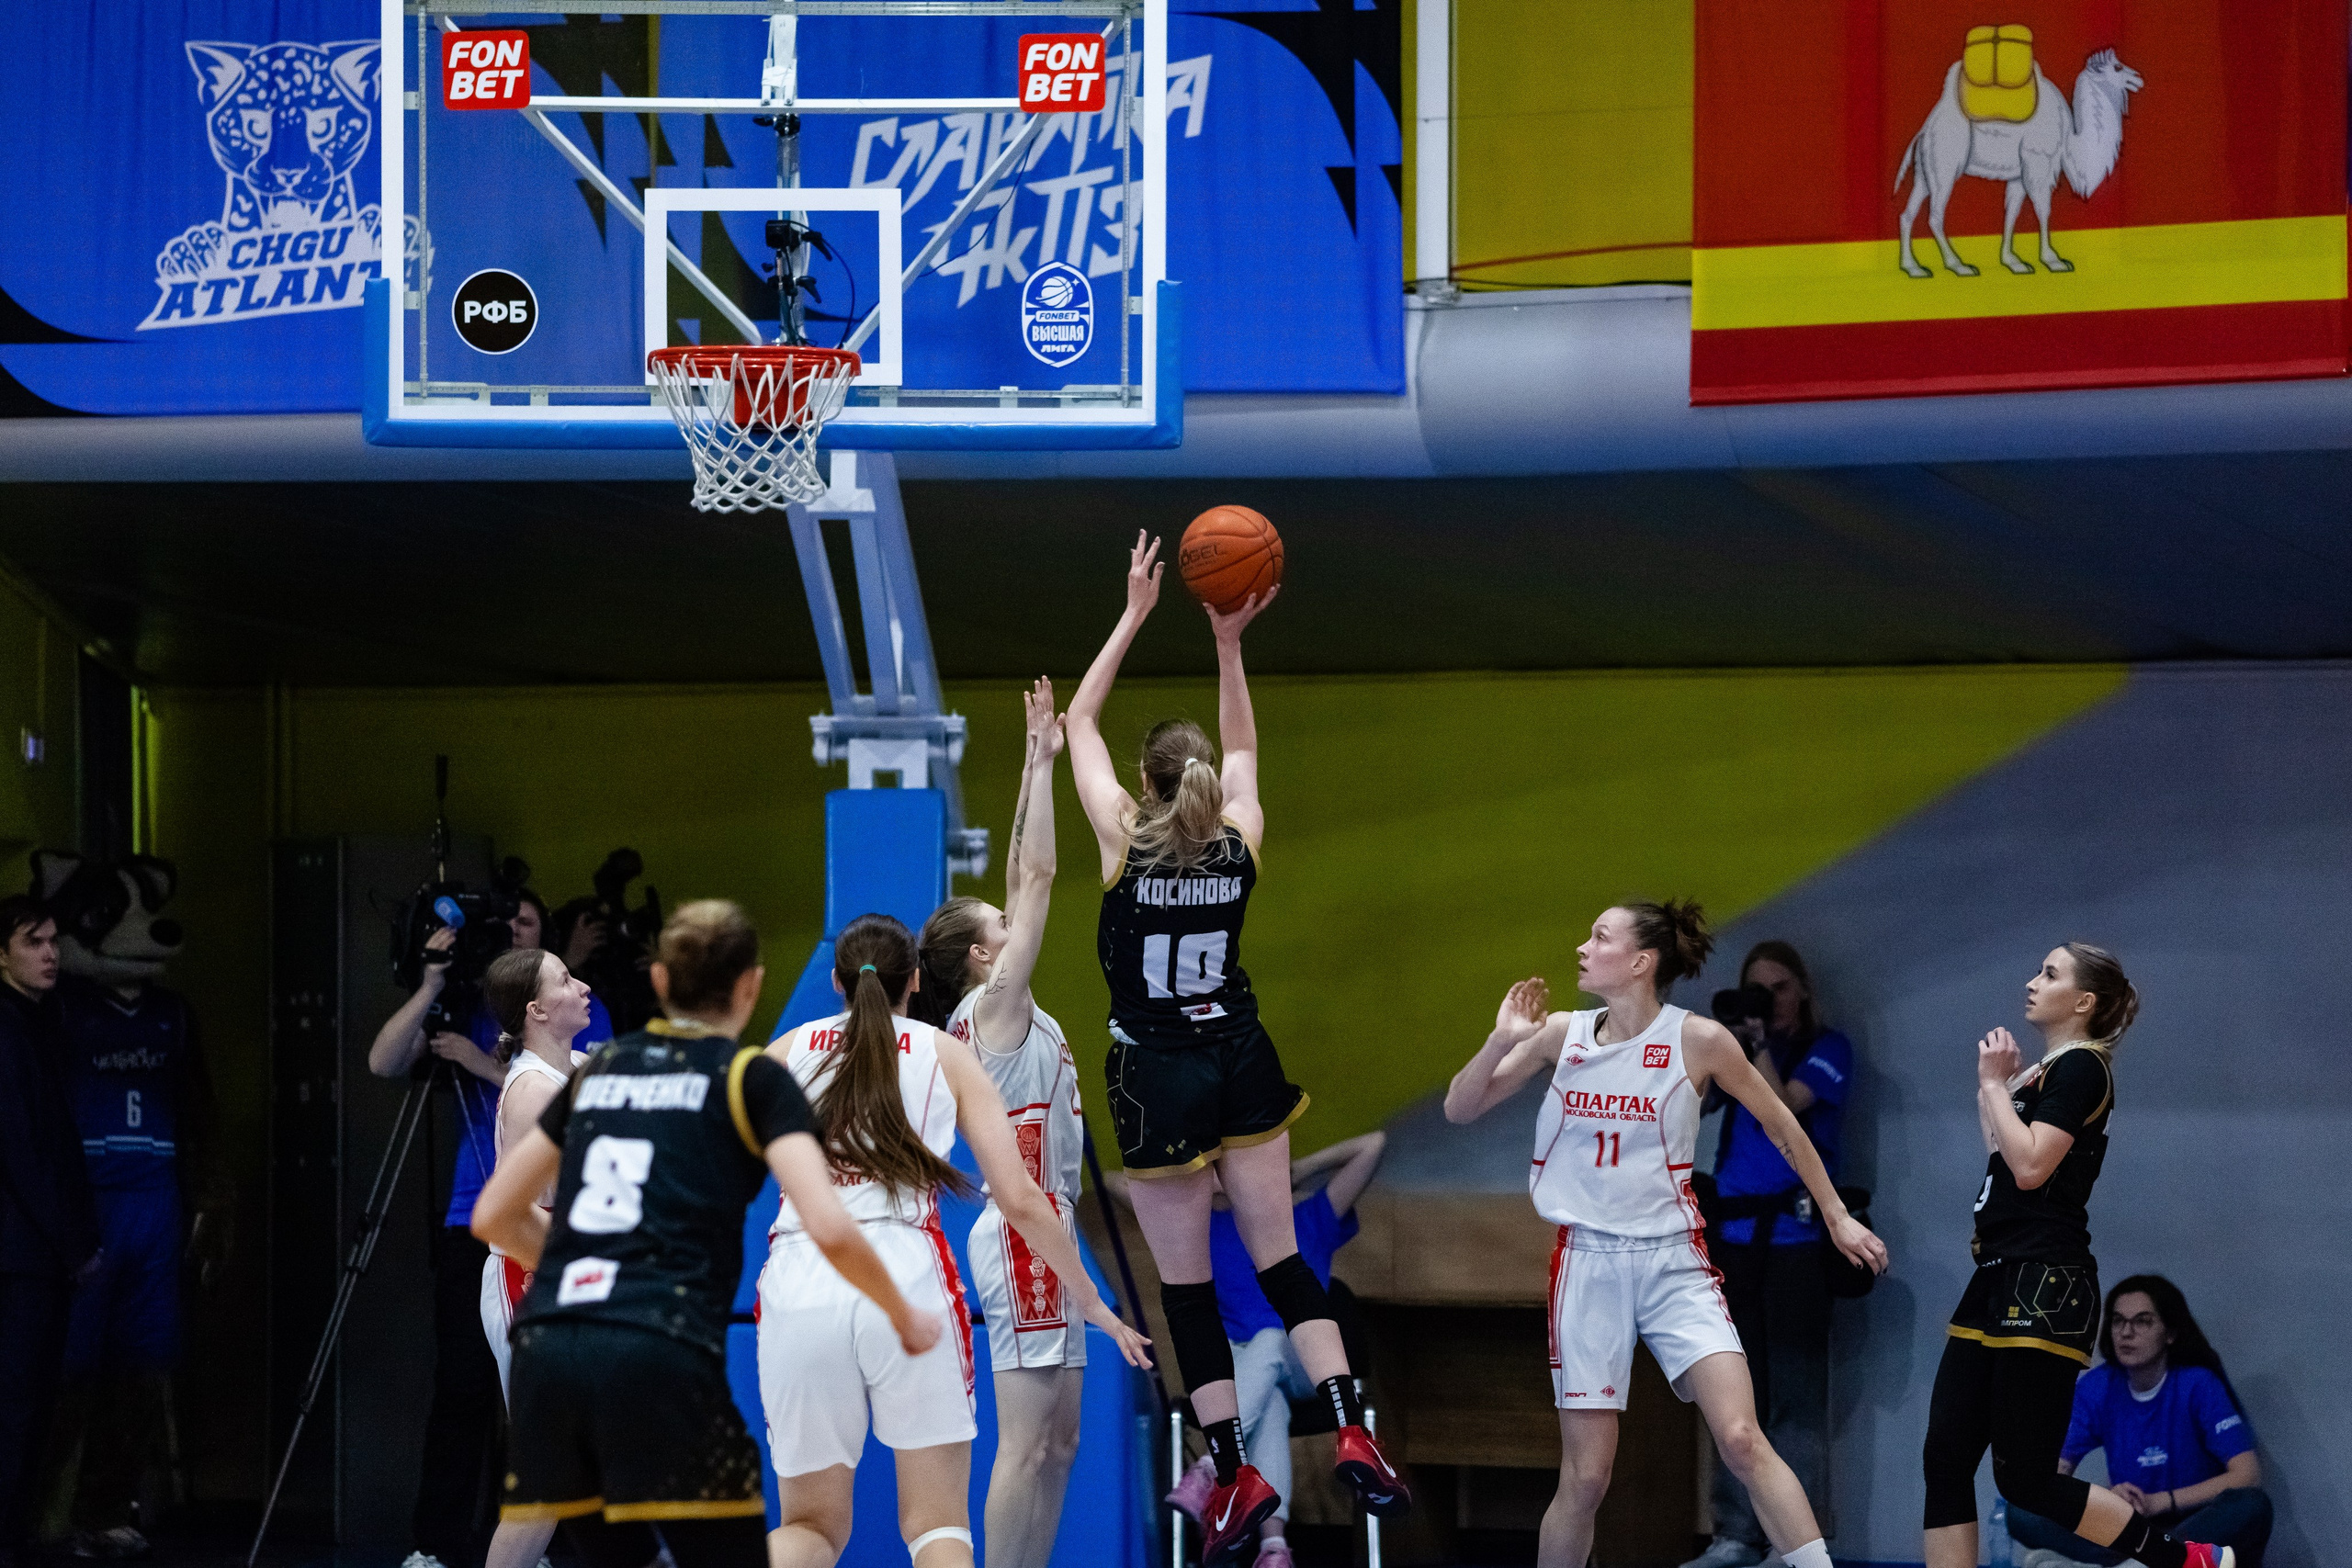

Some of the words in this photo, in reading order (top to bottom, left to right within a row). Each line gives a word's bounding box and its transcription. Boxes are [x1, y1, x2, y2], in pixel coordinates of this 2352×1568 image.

[448, 39, 524, 69] FON
[1023, 42, 1100, 72] FON
[449, 69, 525, 100] BET
[1023, 73, 1100, 102] BET
[228, 226, 350, 271] CHGU
[463, 299, 527, 324] РФБ
[1039, 312, 1076, 321] FONBET
[1032, 324, 1084, 342] ВЫСШАЯ
[1040, 344, 1076, 353] ЛИГА
[1136, 876, 1242, 906] КОСИНОВА
[1142, 930, 1228, 998] 10
[1645, 1046, 1669, 1056] FON
[1645, 1056, 1668, 1066] BET
[127, 1090, 141, 1128] 6
[1565, 1090, 1657, 1114] СПАРТАК
[1566, 1109, 1616, 1120] МОСКОВСКАЯ
[1620, 1111, 1657, 1122] ОБЛАСТЬ
[1593, 1130, 1621, 1168] 11
[568, 1134, 655, 1234] 8
